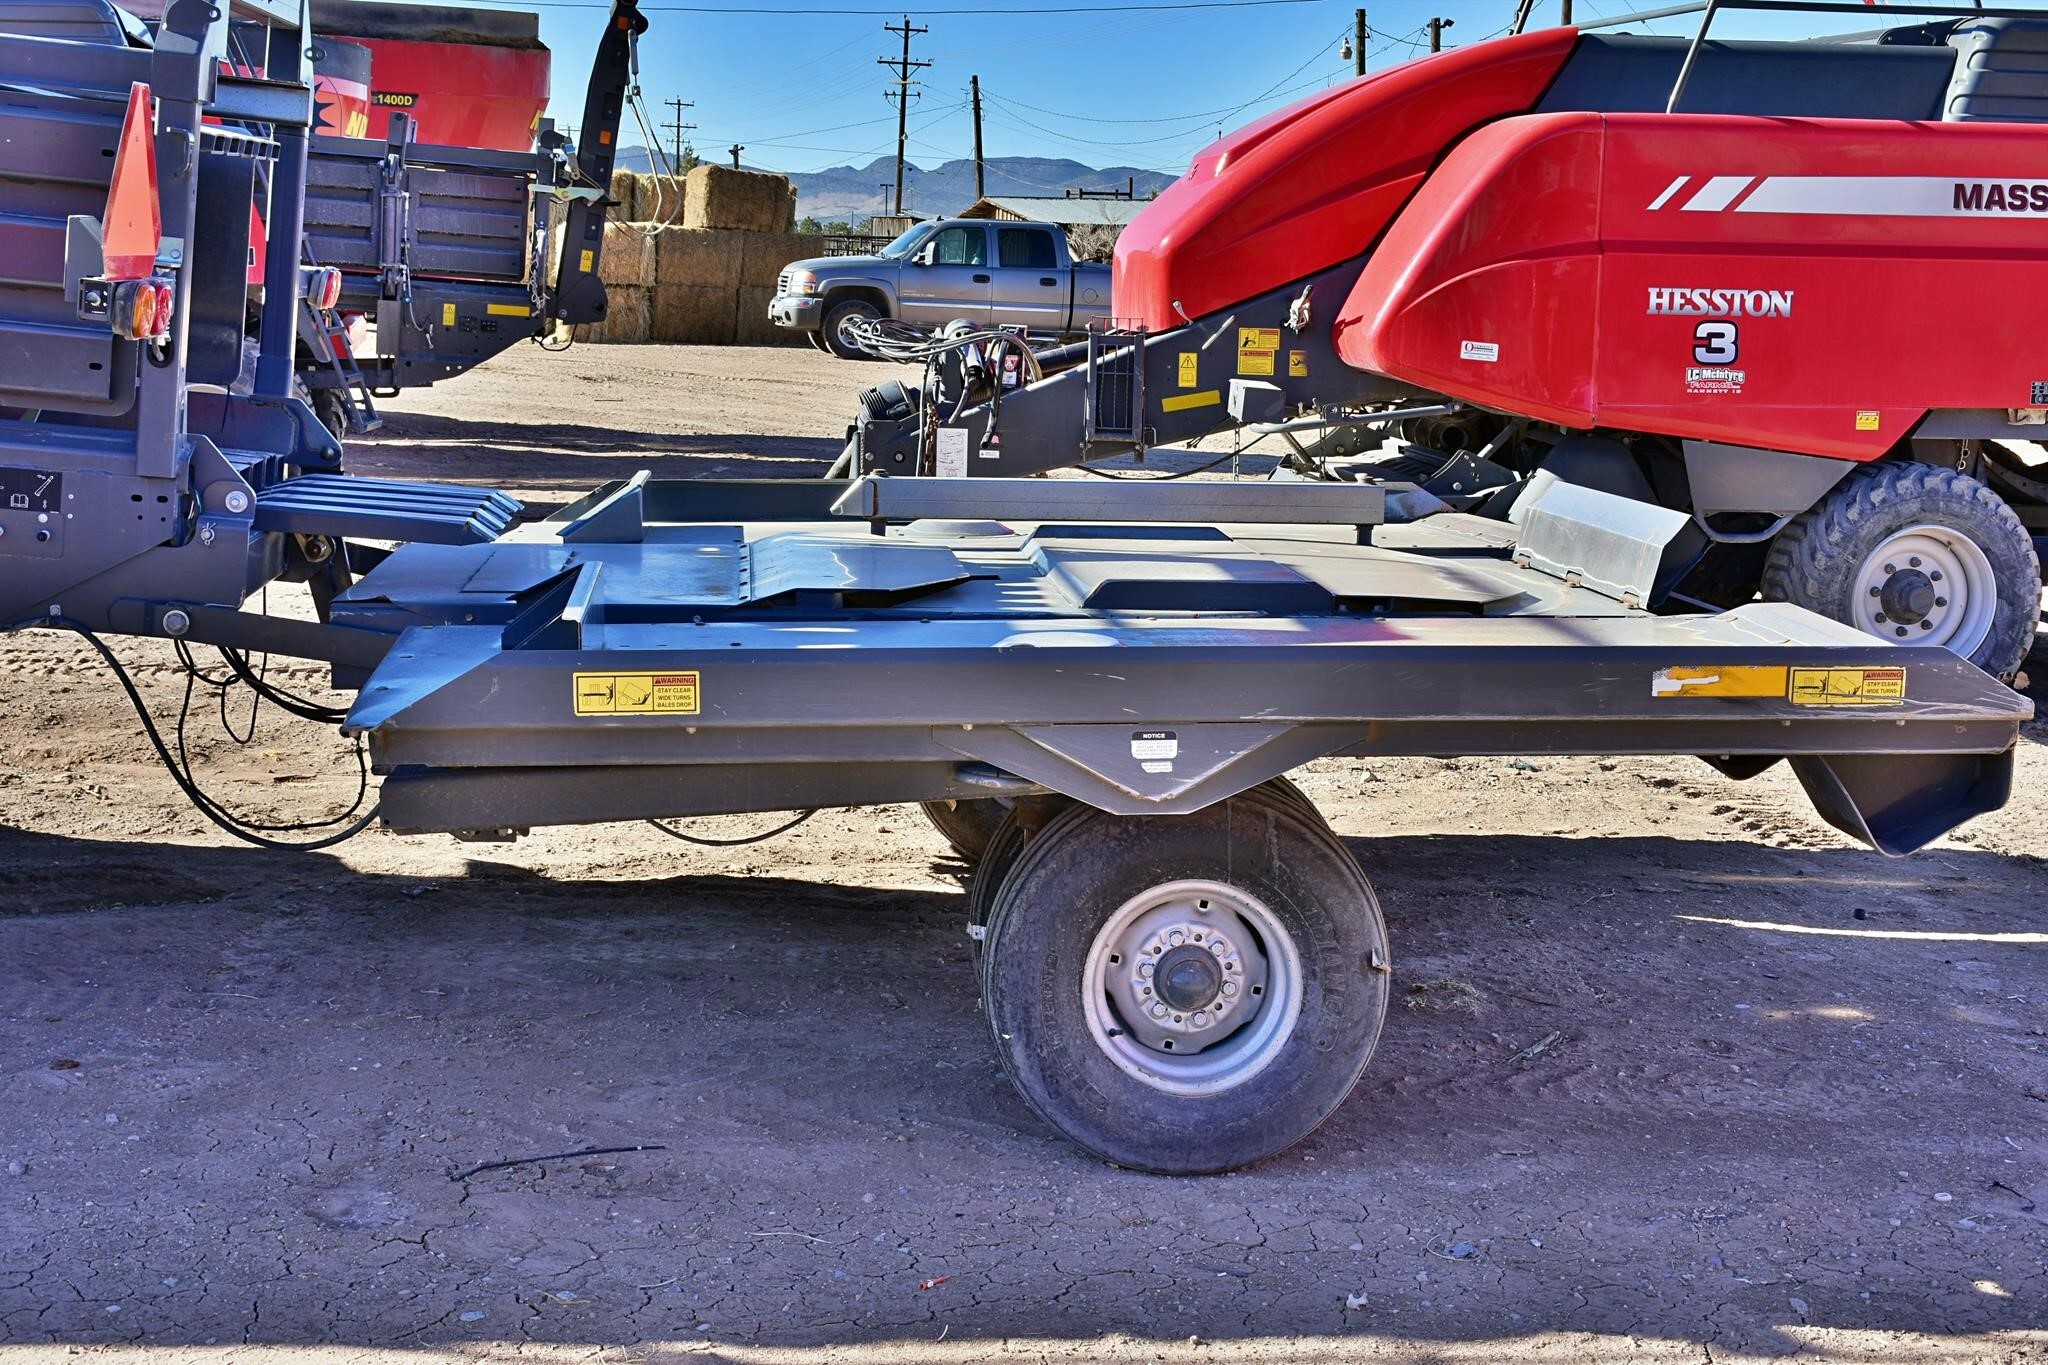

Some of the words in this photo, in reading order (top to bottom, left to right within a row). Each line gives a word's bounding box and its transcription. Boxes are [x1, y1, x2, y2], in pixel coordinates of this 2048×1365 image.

[1953, 183, 2048, 212] MASS
[1647, 287, 1794, 317] HESSTON
[1693, 320, 1739, 365] 3
[1687, 368, 1700, 382] LC
[1702, 368, 1744, 382] McIntyre
